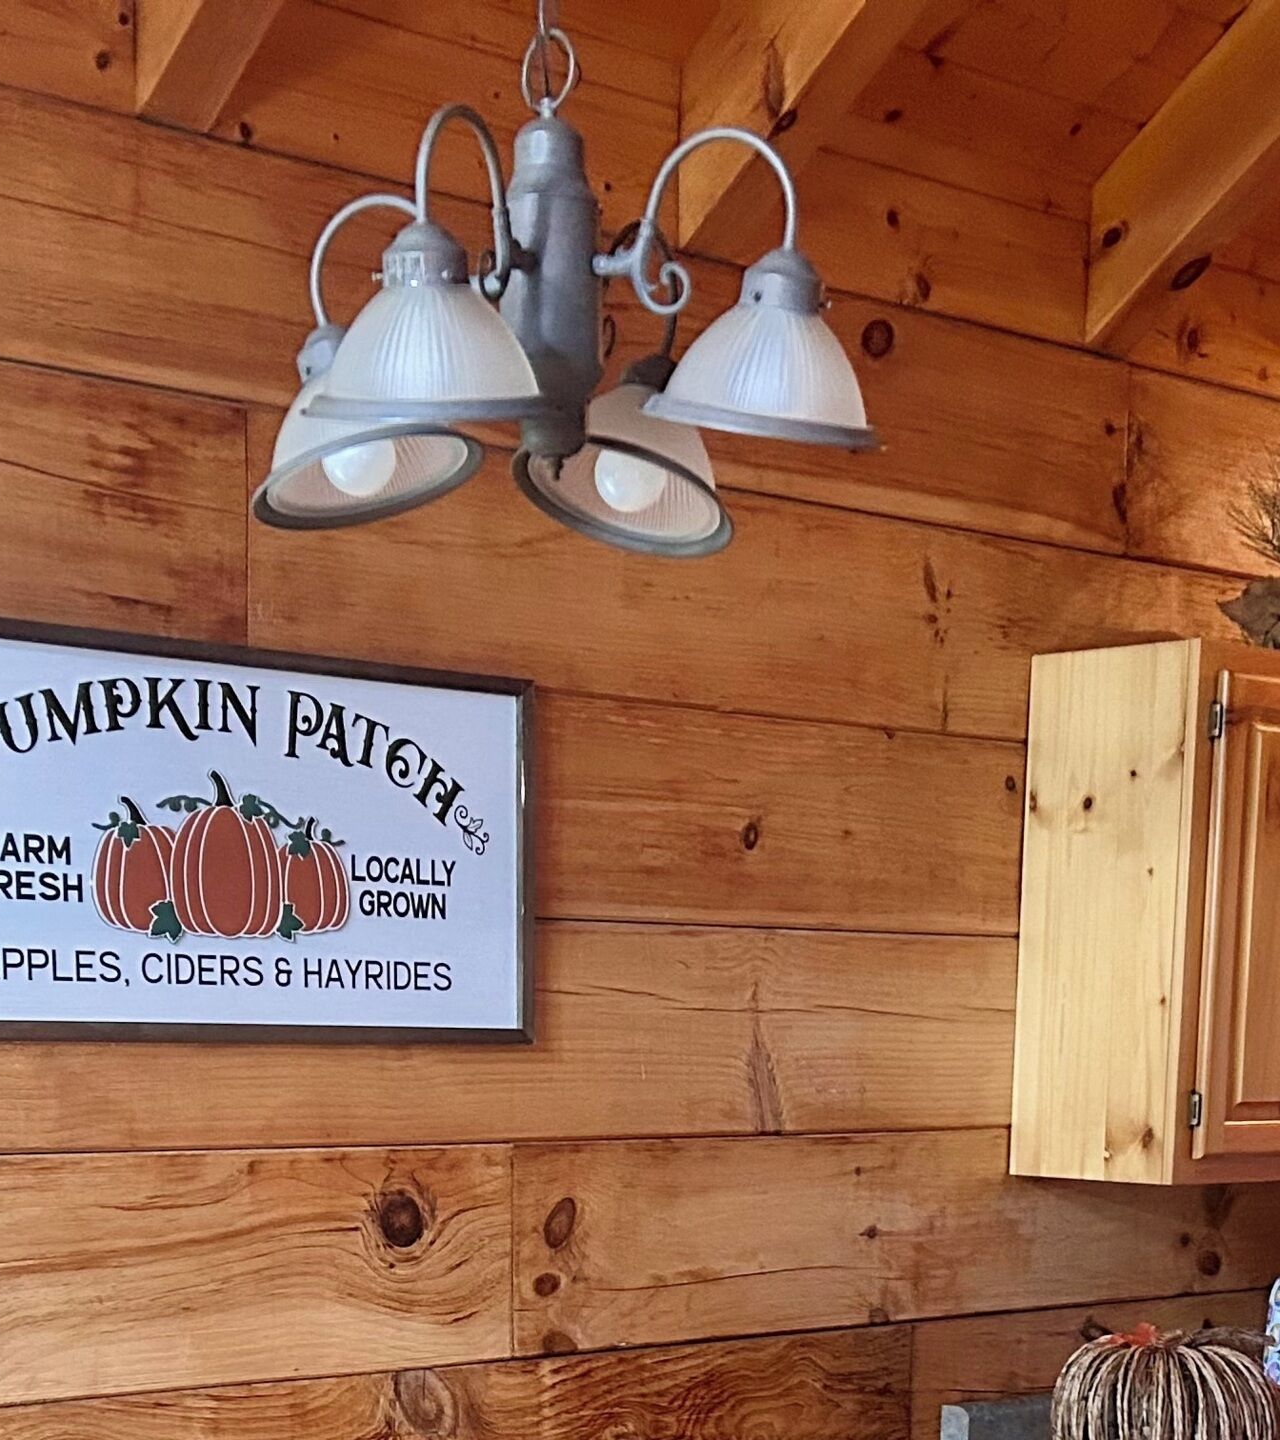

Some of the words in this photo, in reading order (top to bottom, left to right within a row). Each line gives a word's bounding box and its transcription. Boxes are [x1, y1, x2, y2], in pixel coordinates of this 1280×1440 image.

[284, 690, 465, 826] PATCH
[350, 854, 456, 887] LOCALLY
[358, 889, 447, 919] GROWN
[141, 952, 264, 987] CIDERS
[274, 957, 293, 988] &
[303, 957, 453, 991] HAYRIDES
